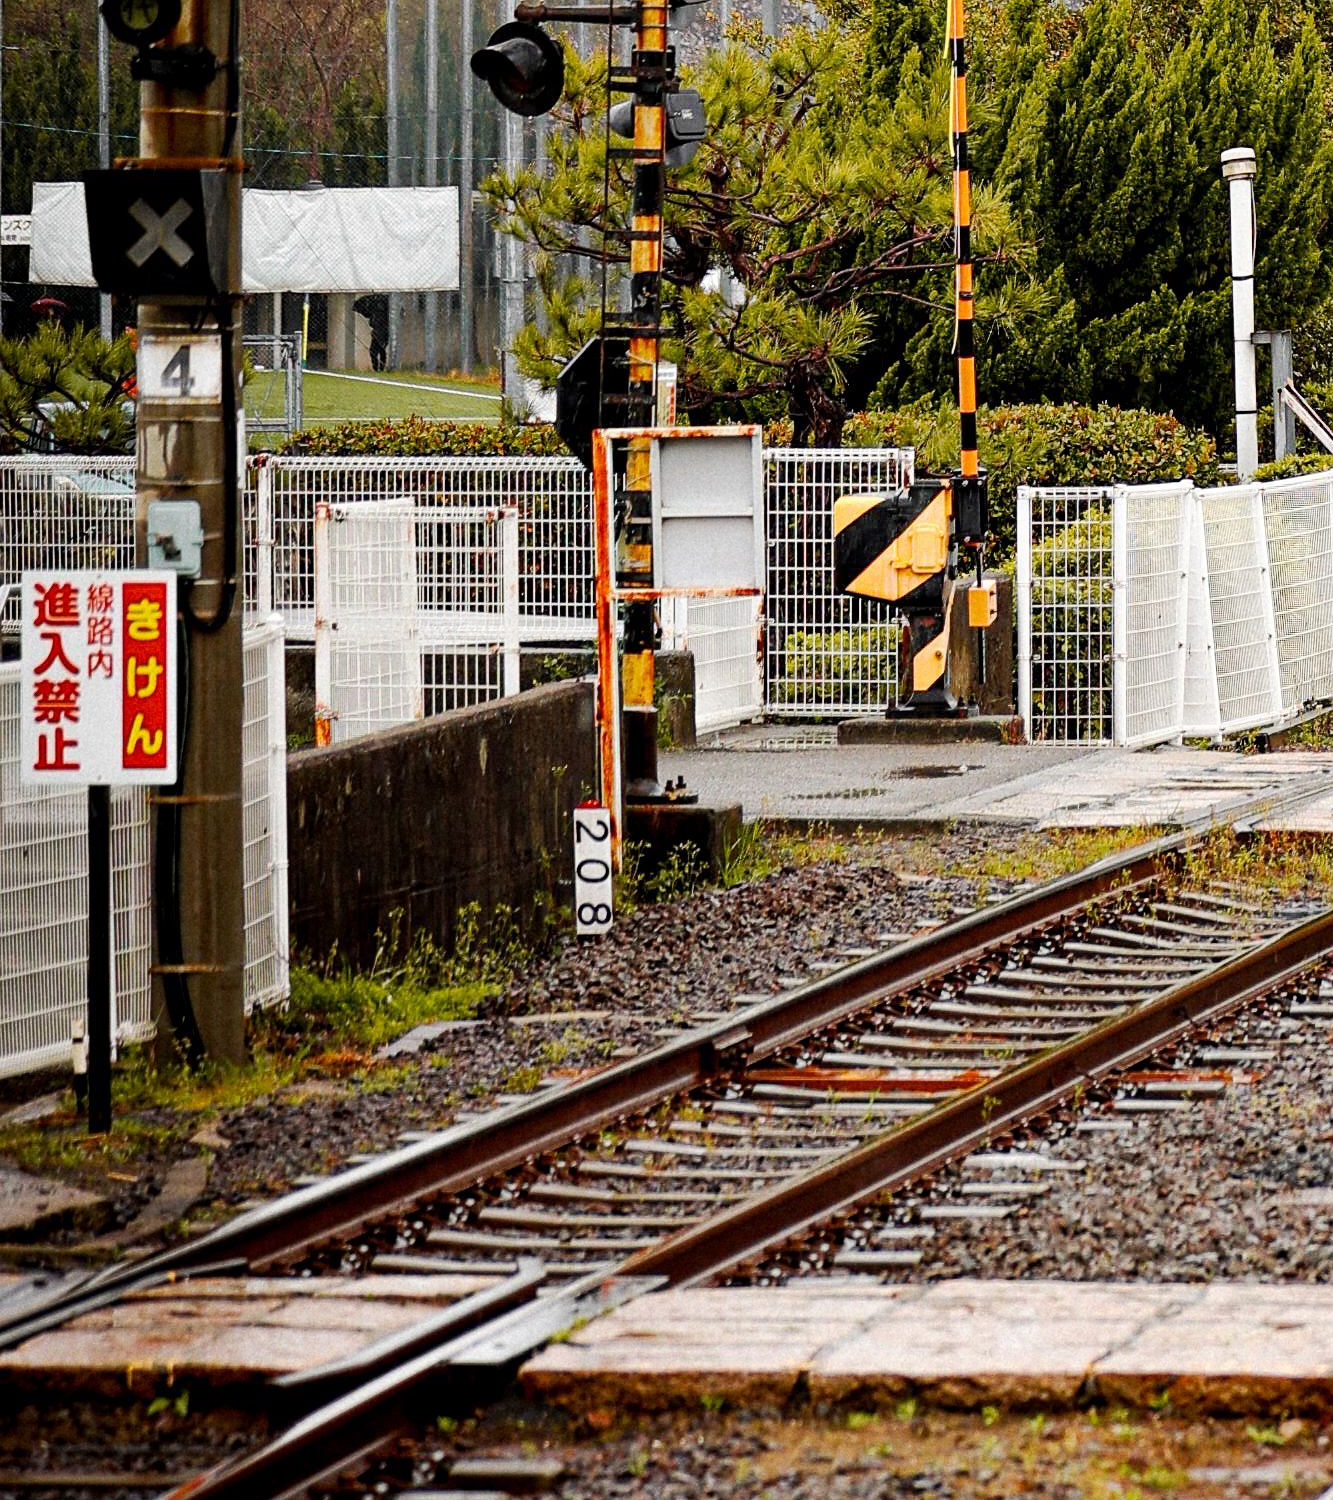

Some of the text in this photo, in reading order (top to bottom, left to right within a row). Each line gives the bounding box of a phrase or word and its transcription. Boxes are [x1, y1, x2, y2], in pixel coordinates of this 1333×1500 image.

[161, 344, 195, 398] 4
[33, 582, 80, 771] 進入禁止
[87, 583, 114, 679] 線路内
[127, 598, 163, 756] きけん
[575, 819, 612, 926] 208
